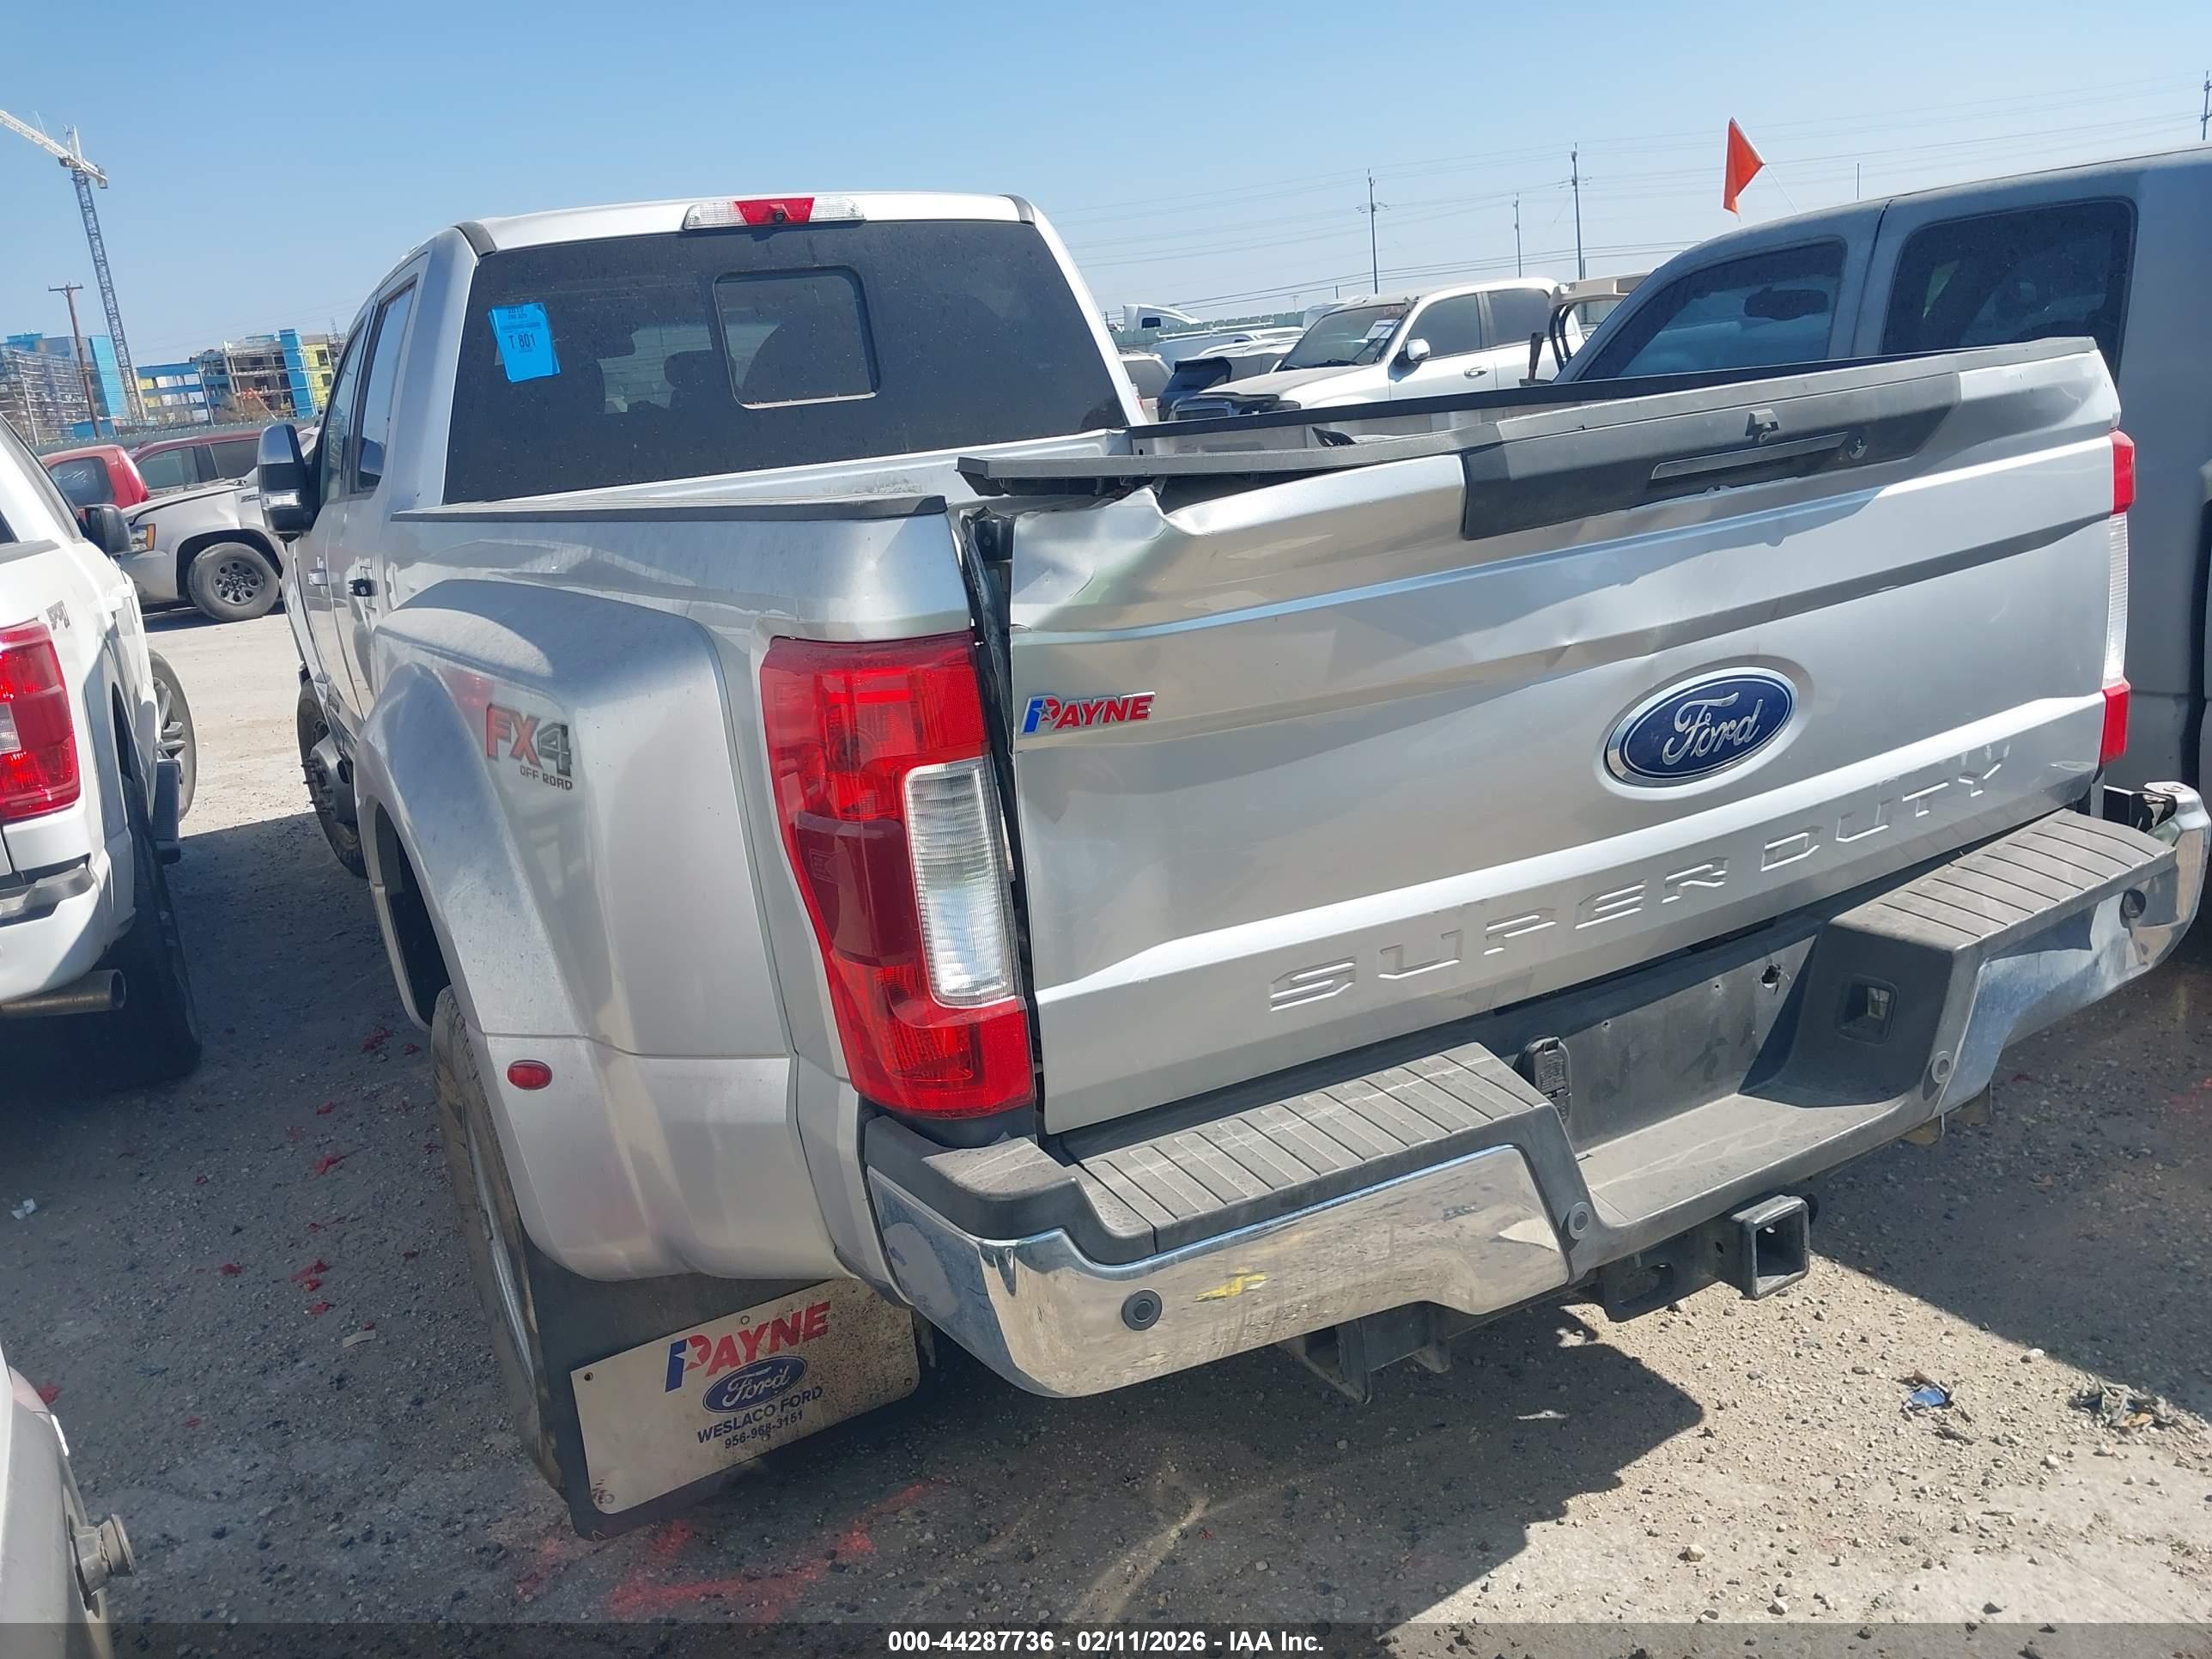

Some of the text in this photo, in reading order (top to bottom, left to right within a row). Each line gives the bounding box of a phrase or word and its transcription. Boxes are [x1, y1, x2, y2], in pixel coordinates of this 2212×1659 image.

[508, 332, 536, 349] T 801
[486, 703, 572, 777] FX4
[1021, 691, 1155, 735] PAYNE
[1662, 691, 1764, 765] Ford
[520, 764, 573, 791] OFF ROAD
[1270, 758, 2003, 1012] SUPER DUTY
[665, 1300, 831, 1393] PAYNE
[696, 1385, 823, 1444] WESLACO FORD
[721, 1364, 792, 1407] Ford
